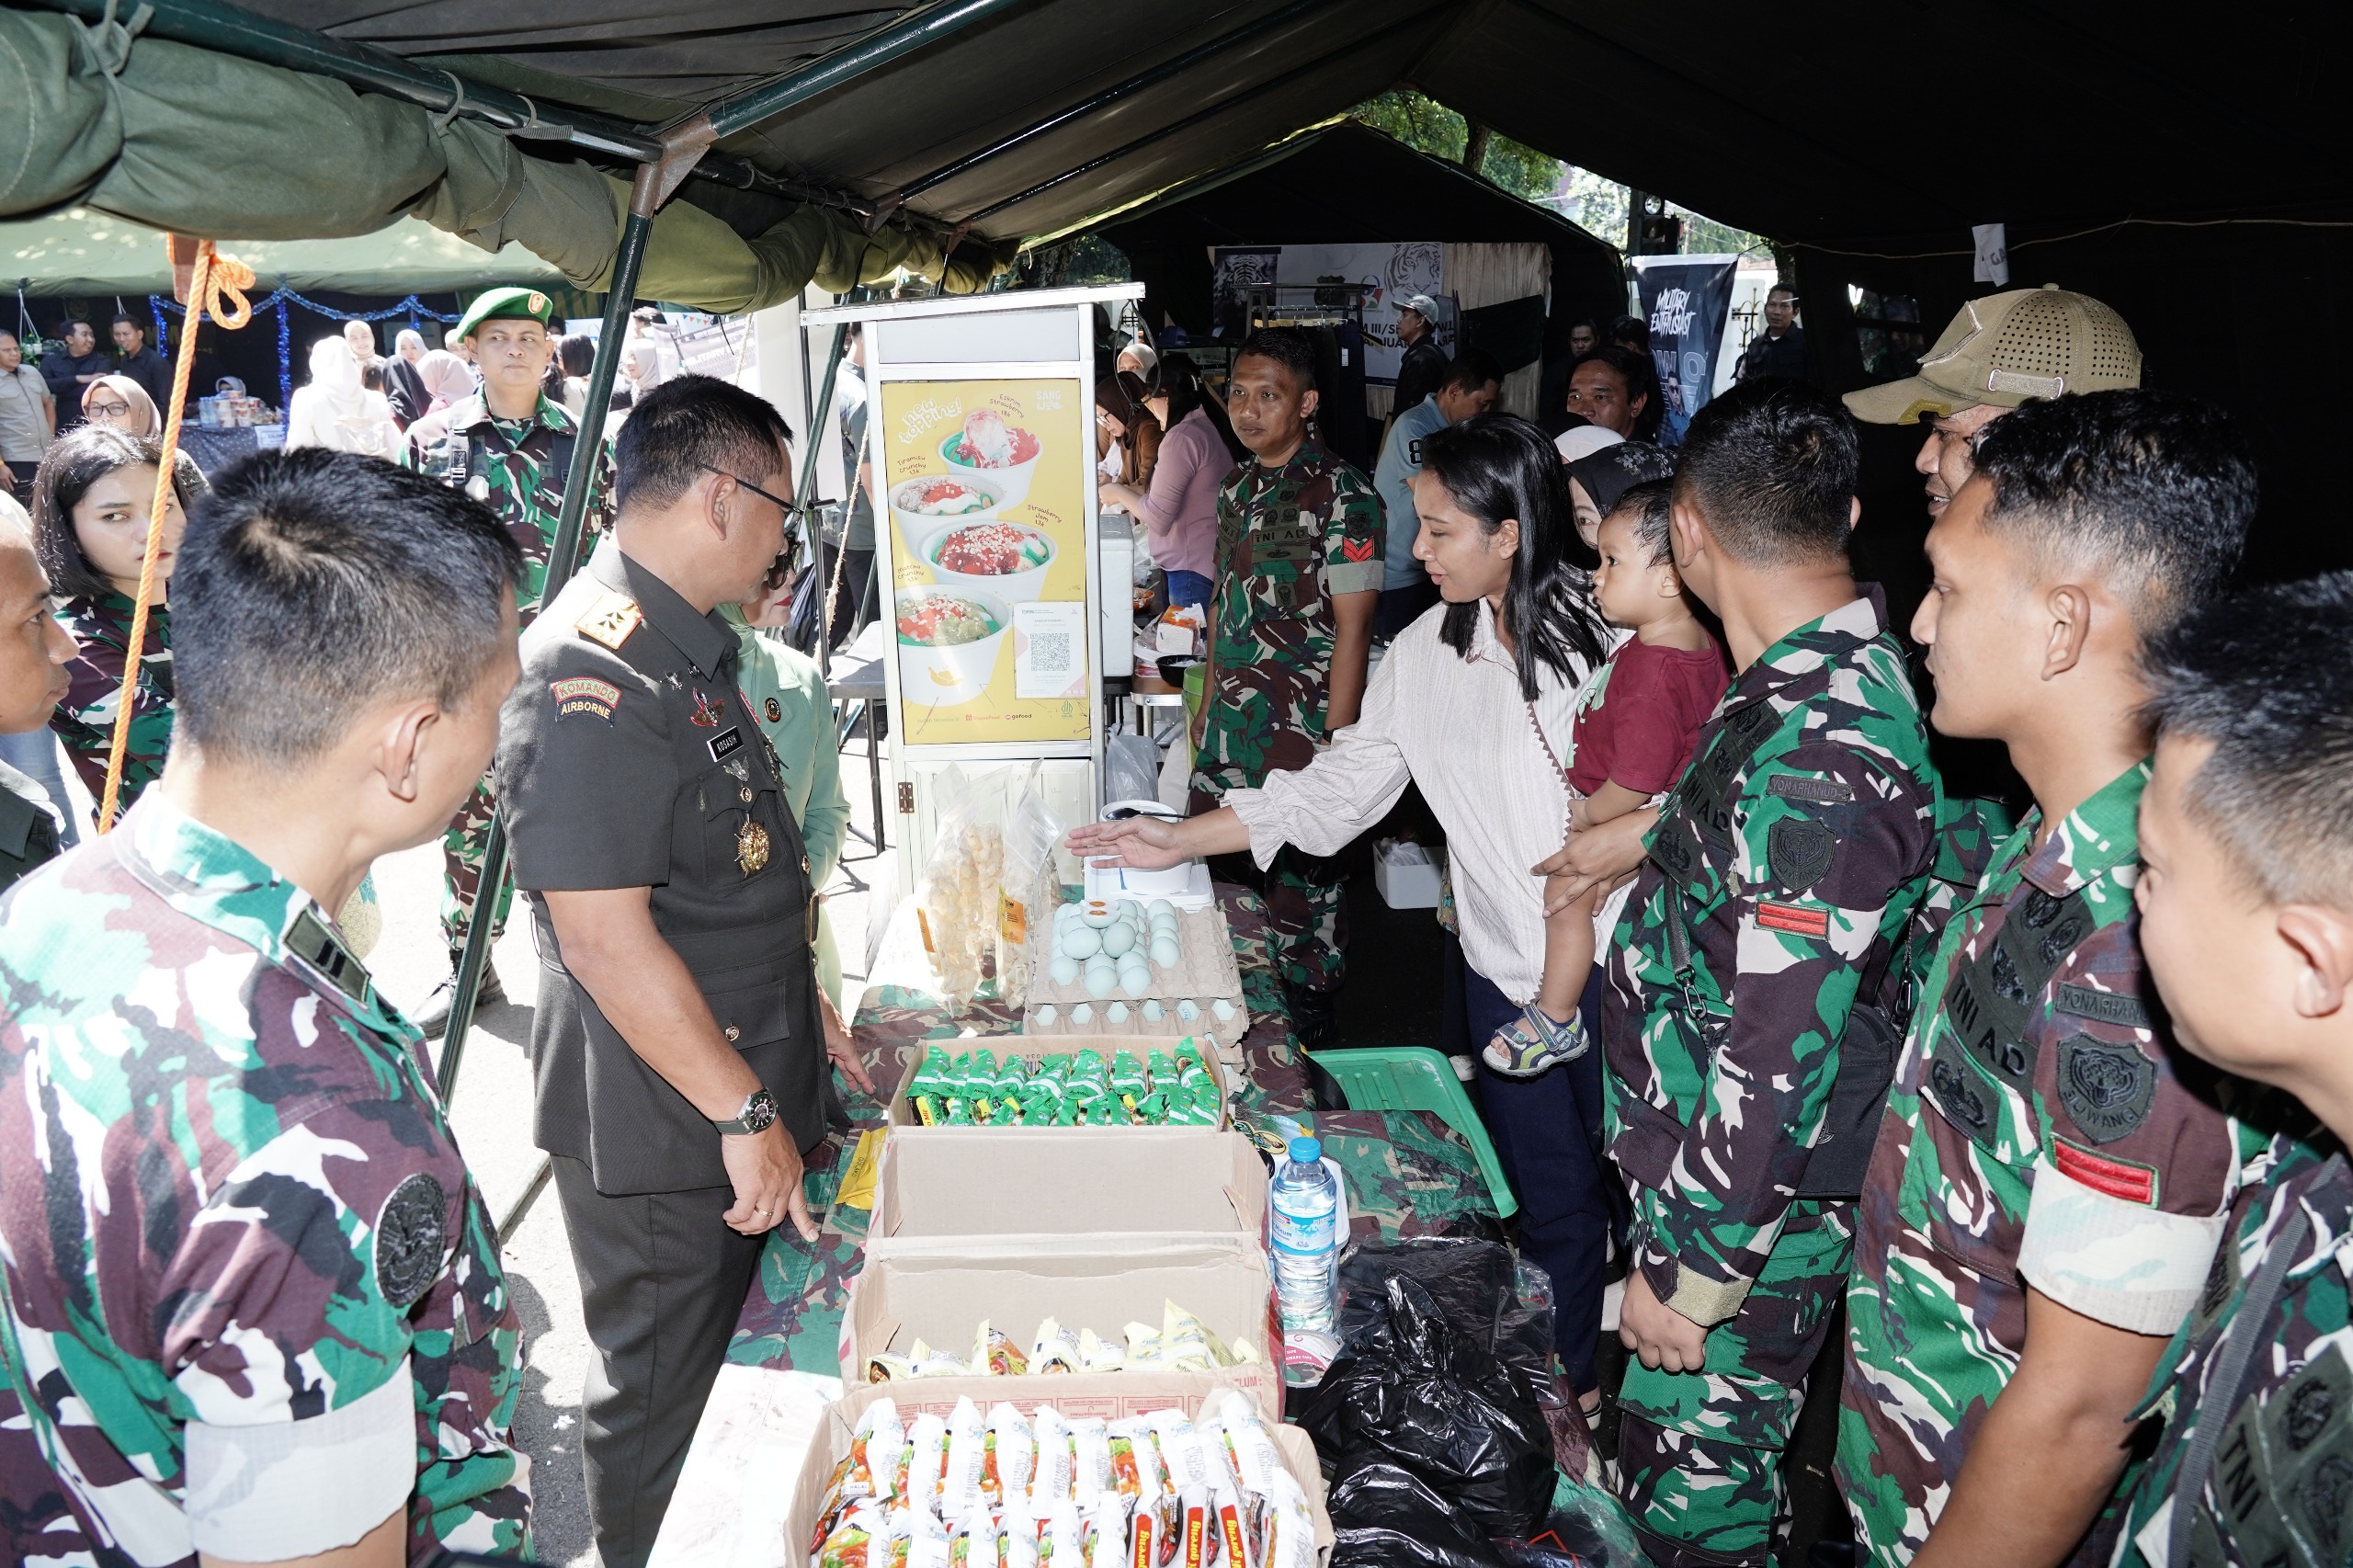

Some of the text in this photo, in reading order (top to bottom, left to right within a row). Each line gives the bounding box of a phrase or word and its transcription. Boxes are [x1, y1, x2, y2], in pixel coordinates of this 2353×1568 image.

[1655, 288, 1691, 314] MILITARY
[1650, 312, 1696, 340] ENTHUSIAST
[989, 398, 1025, 419] Strawberry
[1027, 504, 1063, 524] Strawberry
[1256, 529, 1305, 542] TNI AD
[559, 682, 615, 700] KOMANDO
[561, 701, 611, 719] AIRBORNE
[717, 734, 738, 753] KOSASIH
[1697, 798, 1729, 832] AD
[1951, 970, 2026, 1077] TNI AD
[1190, 1520, 1202, 1562] goreng
[1226, 1519, 1243, 1559] goreng
